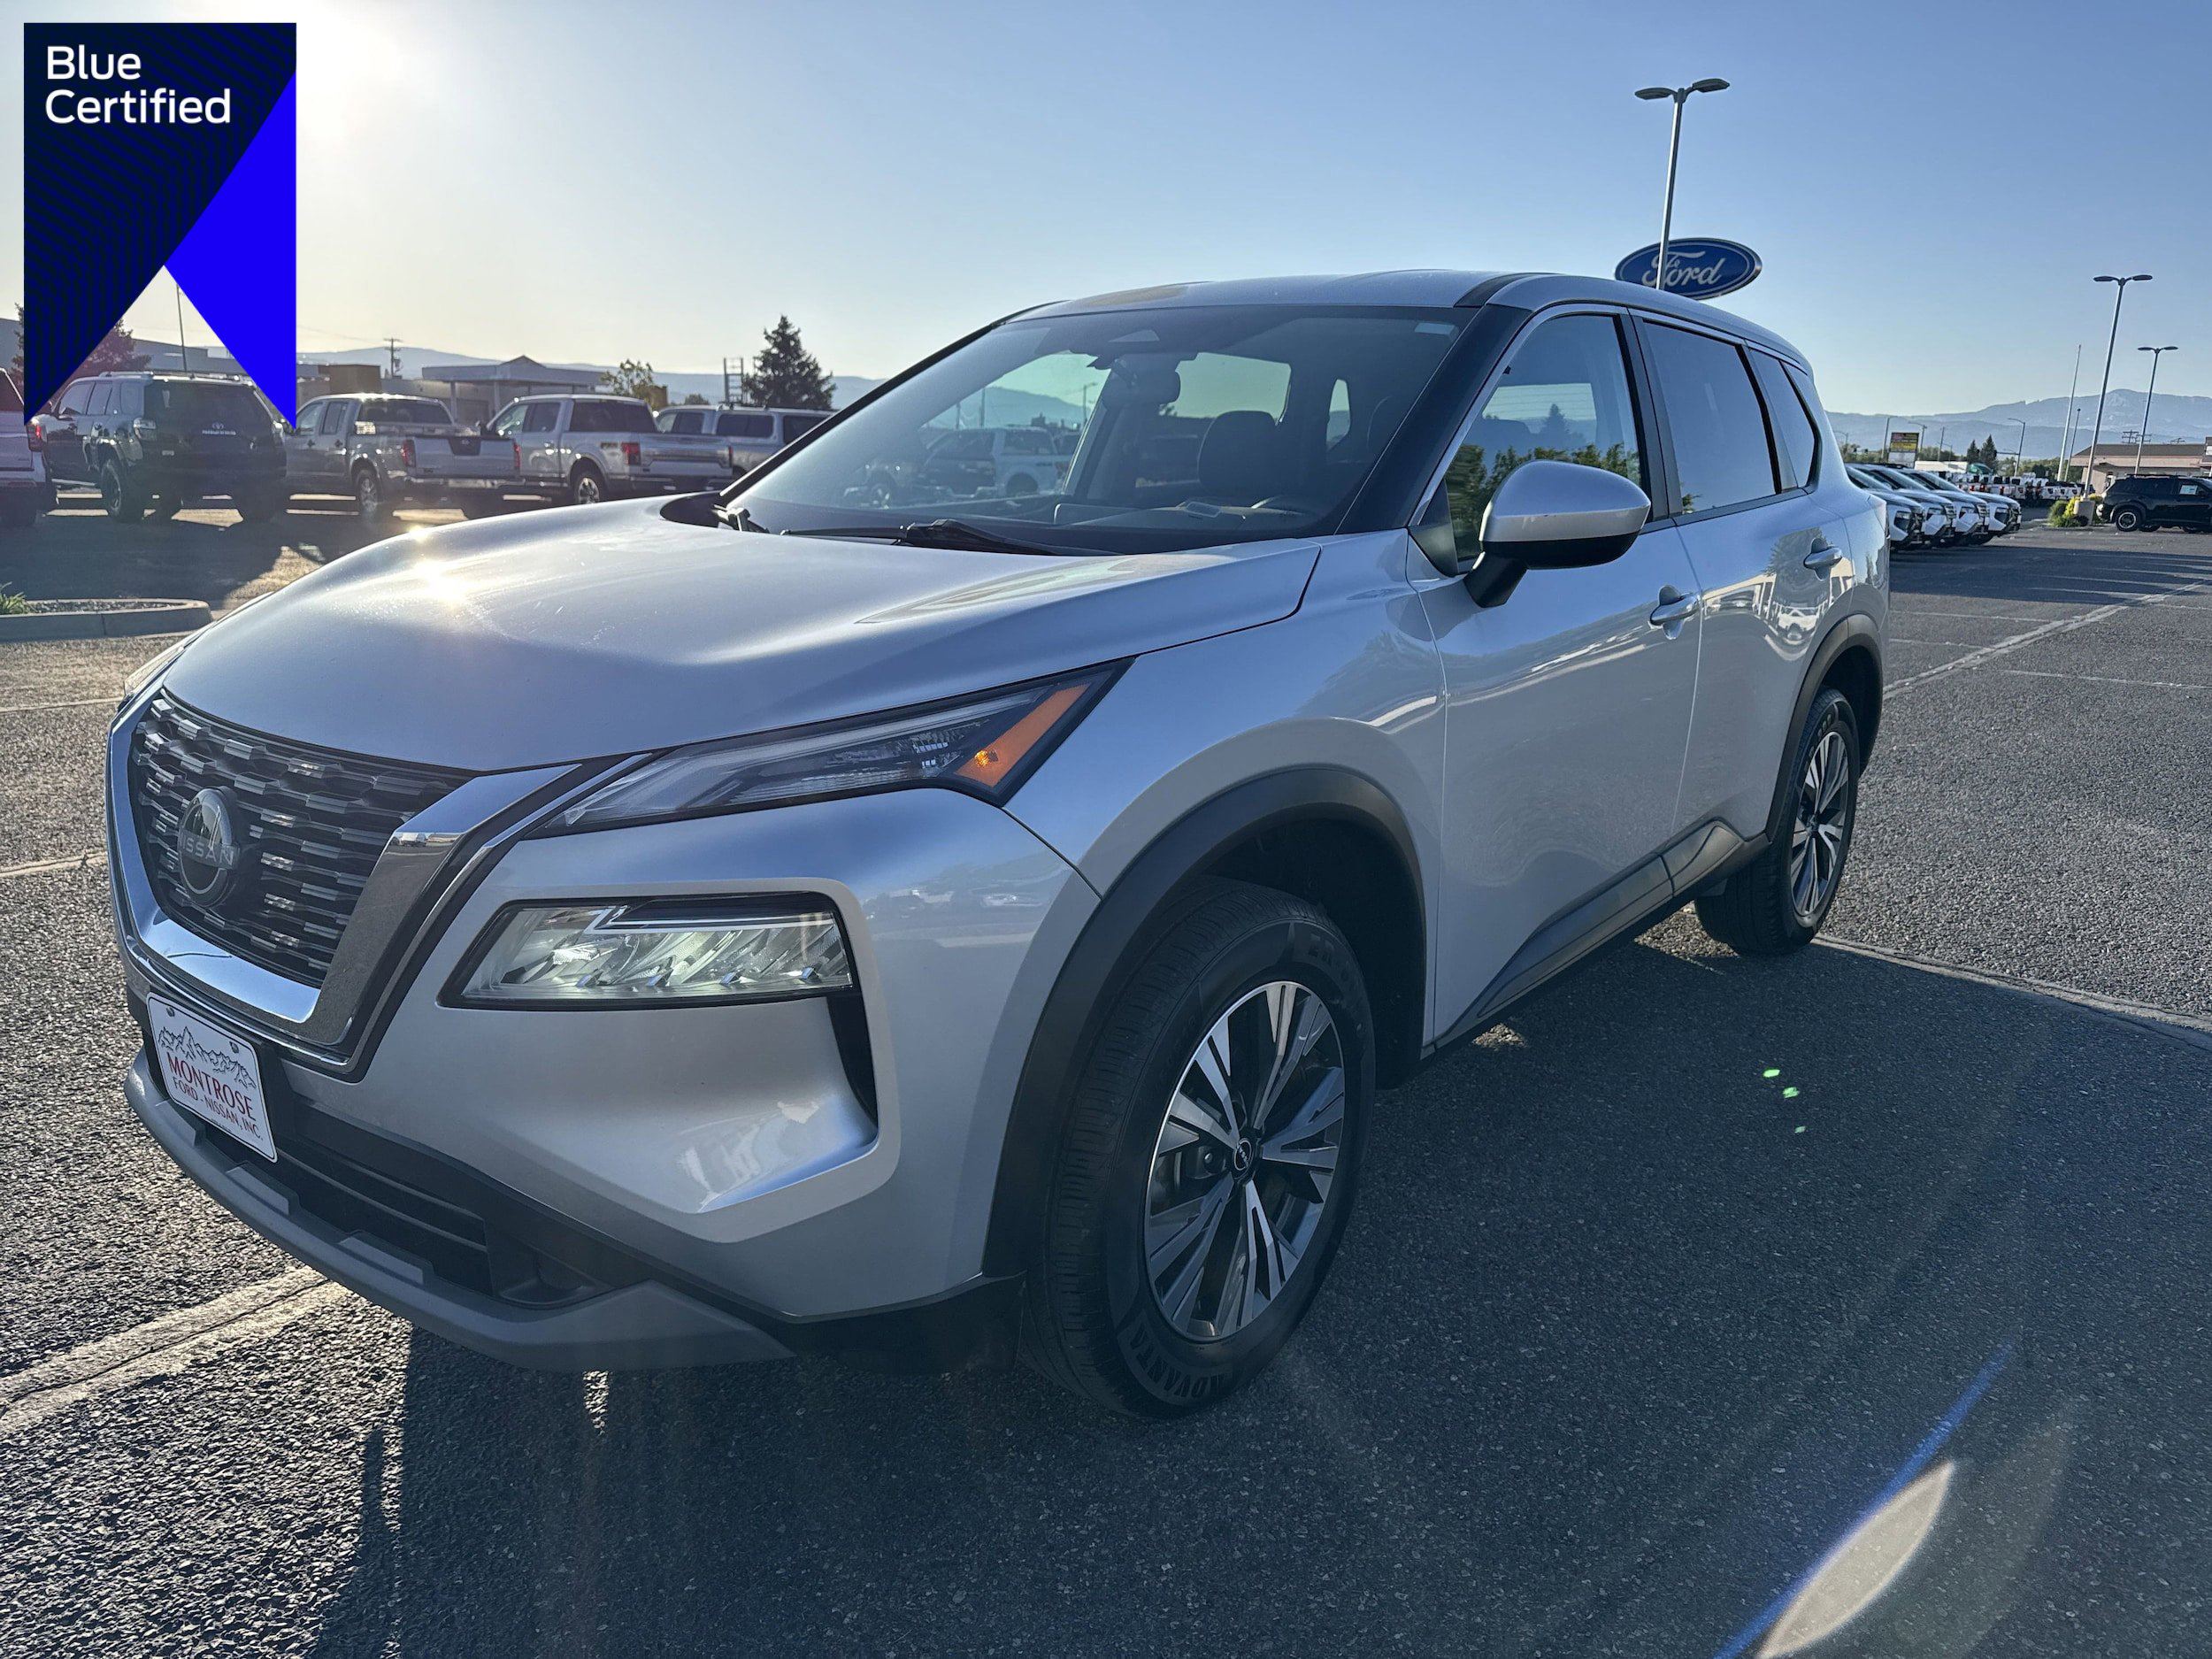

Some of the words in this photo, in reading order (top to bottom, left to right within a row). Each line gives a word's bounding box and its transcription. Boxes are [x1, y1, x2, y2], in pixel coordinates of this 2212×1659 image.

[1641, 250, 1725, 287] Ford
[166, 1051, 257, 1121] MONTROSE
[173, 1076, 198, 1102] FORD
[204, 1096, 243, 1131] NISSAN,
[243, 1117, 264, 1141] INC.
